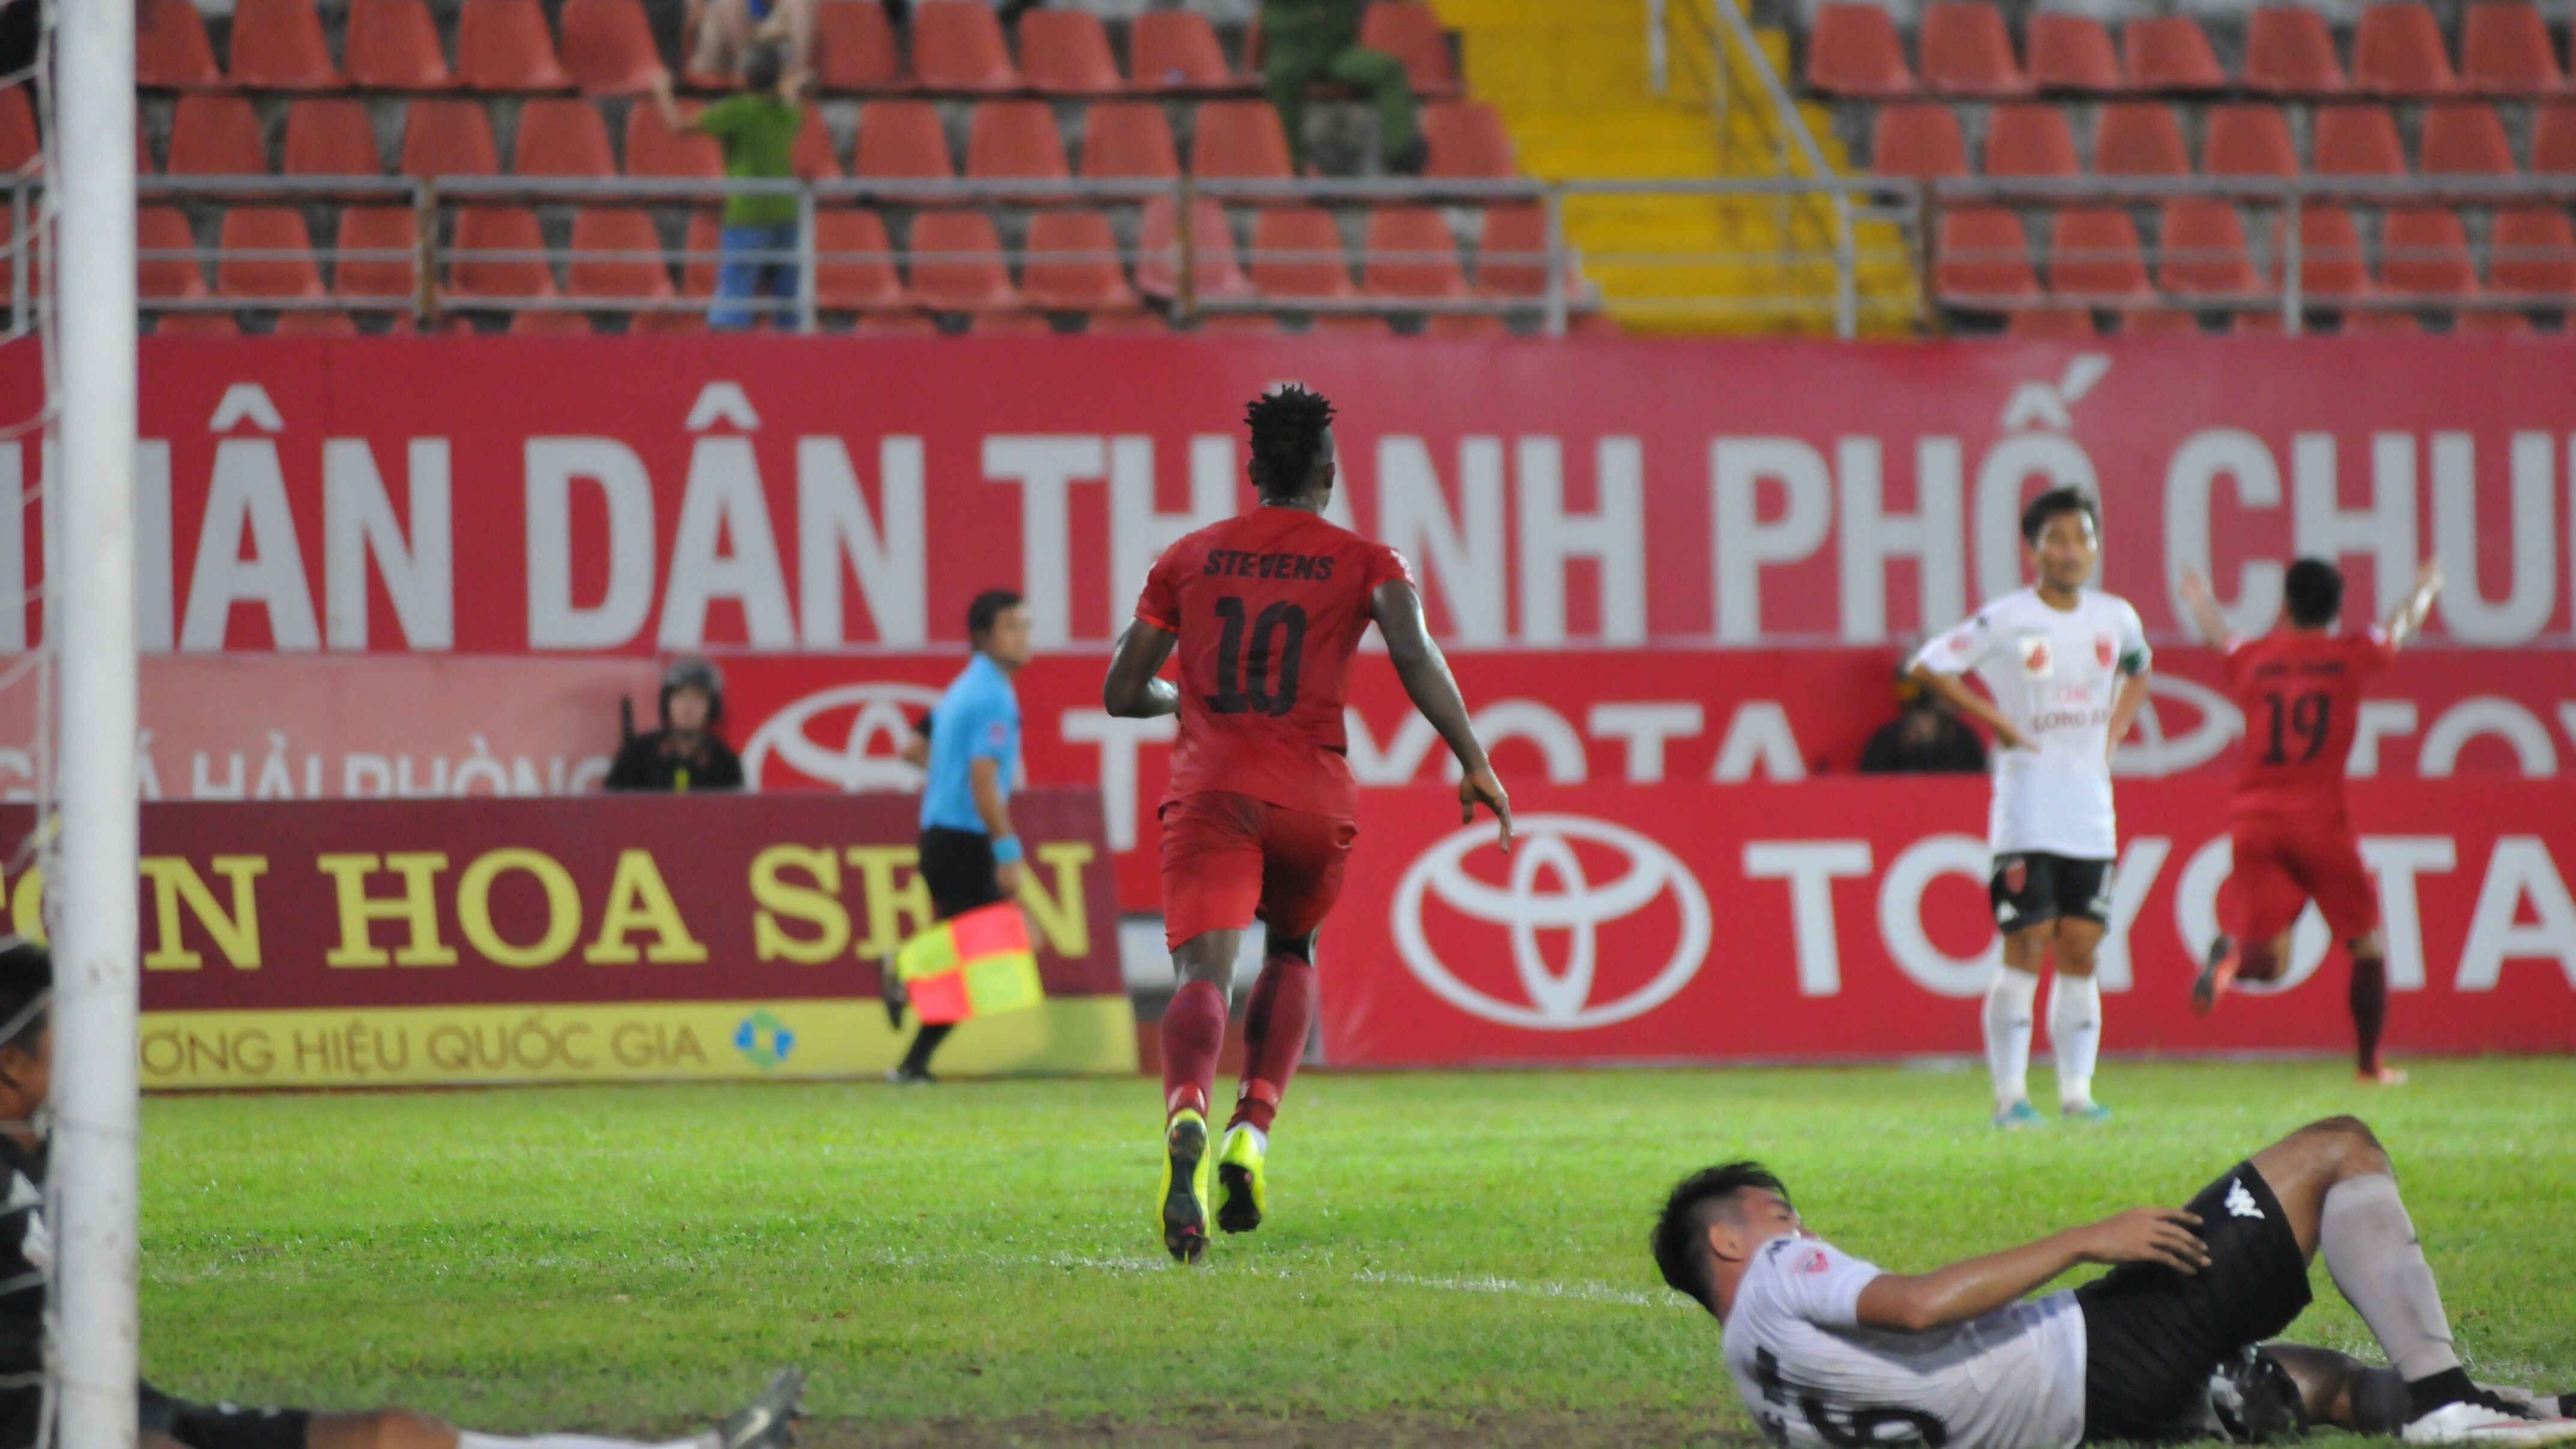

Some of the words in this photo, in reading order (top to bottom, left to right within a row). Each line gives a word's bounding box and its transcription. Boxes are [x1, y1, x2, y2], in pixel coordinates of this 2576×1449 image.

[523, 381, 928, 651] DÂN
[1710, 354, 2113, 648] PHỐ
[2164, 427, 2576, 648] CHU
[1203, 549, 1336, 582] STEVENS
[1204, 596, 1308, 717] 10
[2264, 692, 2332, 766] 19
[317, 847, 708, 967] HOA
[610, 1019, 709, 1069] GIA
